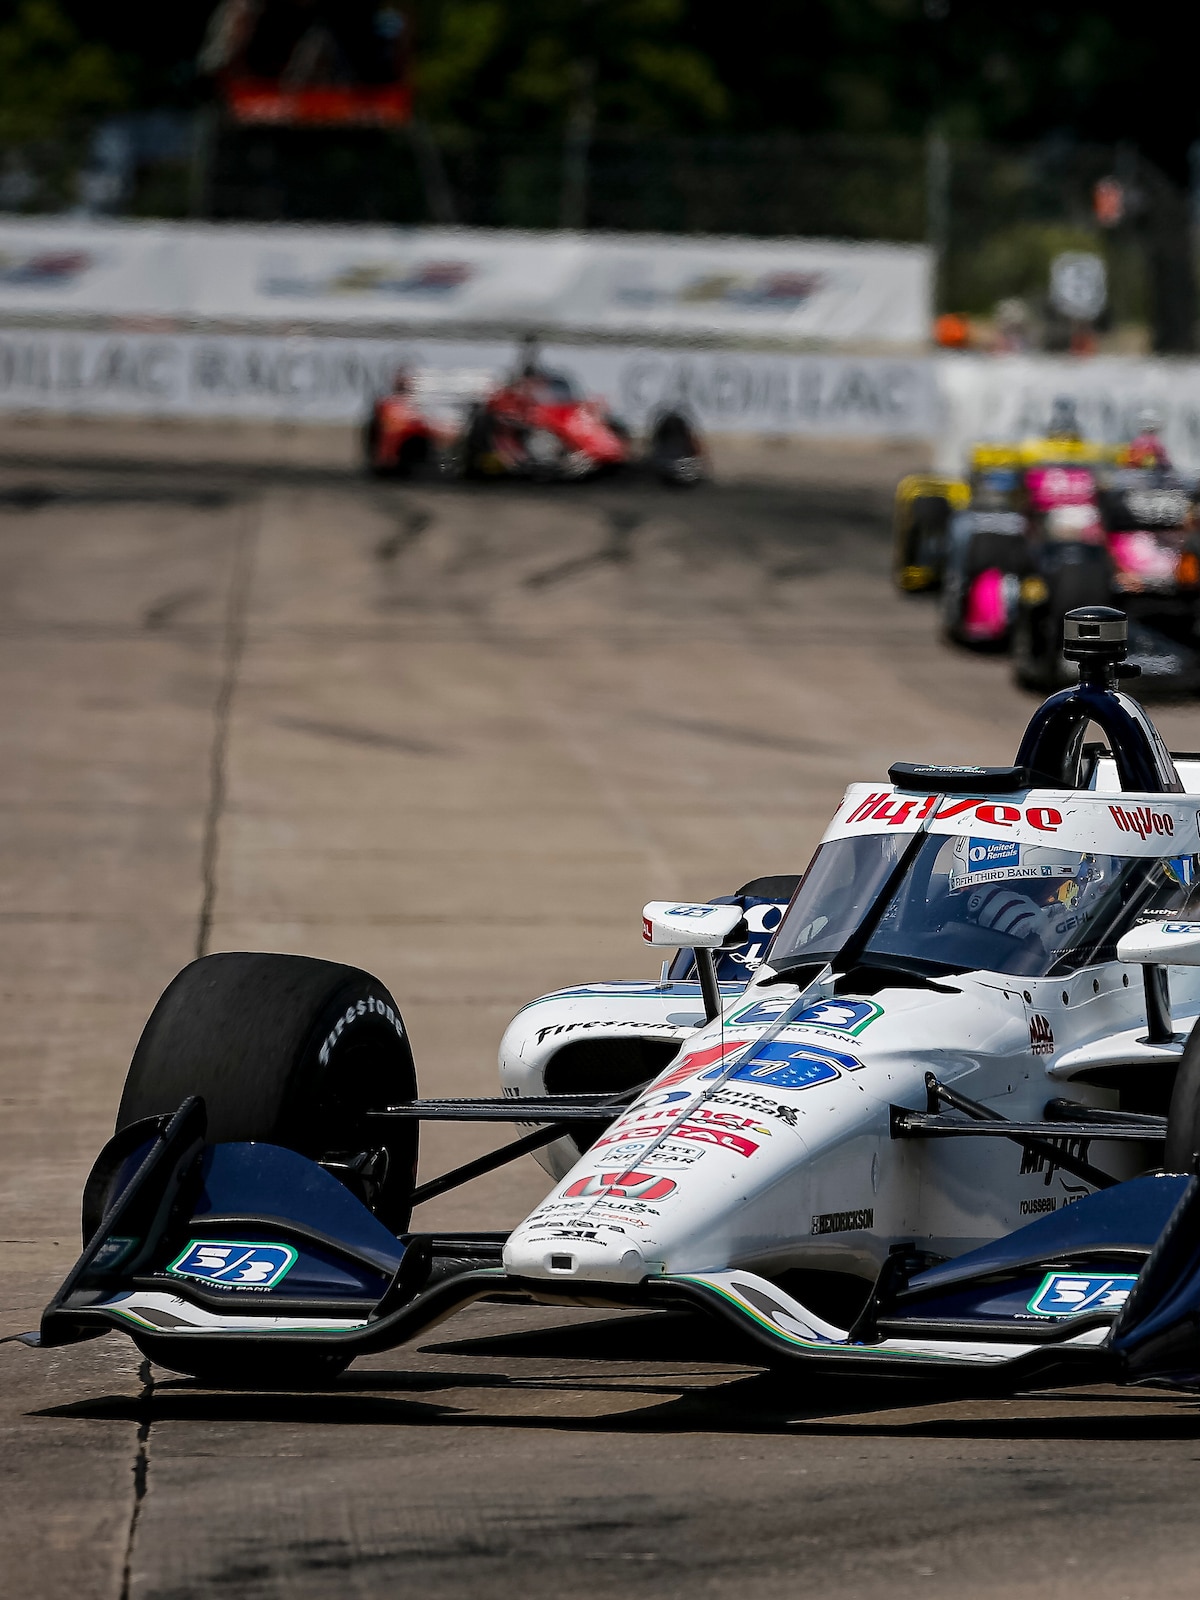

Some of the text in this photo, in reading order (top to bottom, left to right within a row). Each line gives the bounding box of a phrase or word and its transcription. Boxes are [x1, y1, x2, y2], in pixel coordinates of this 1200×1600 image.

[987, 842, 1016, 852] United
[986, 849, 1018, 861] Rentals
[974, 870, 1005, 883] THIRD
[1007, 867, 1038, 877] BANK
[535, 1020, 681, 1046] Firestone
[814, 1029, 864, 1047] BANK
[1031, 1043, 1054, 1056] TOOLS
[600, 1153, 696, 1164] INDCAR
[1020, 1196, 1057, 1216] rousseau
